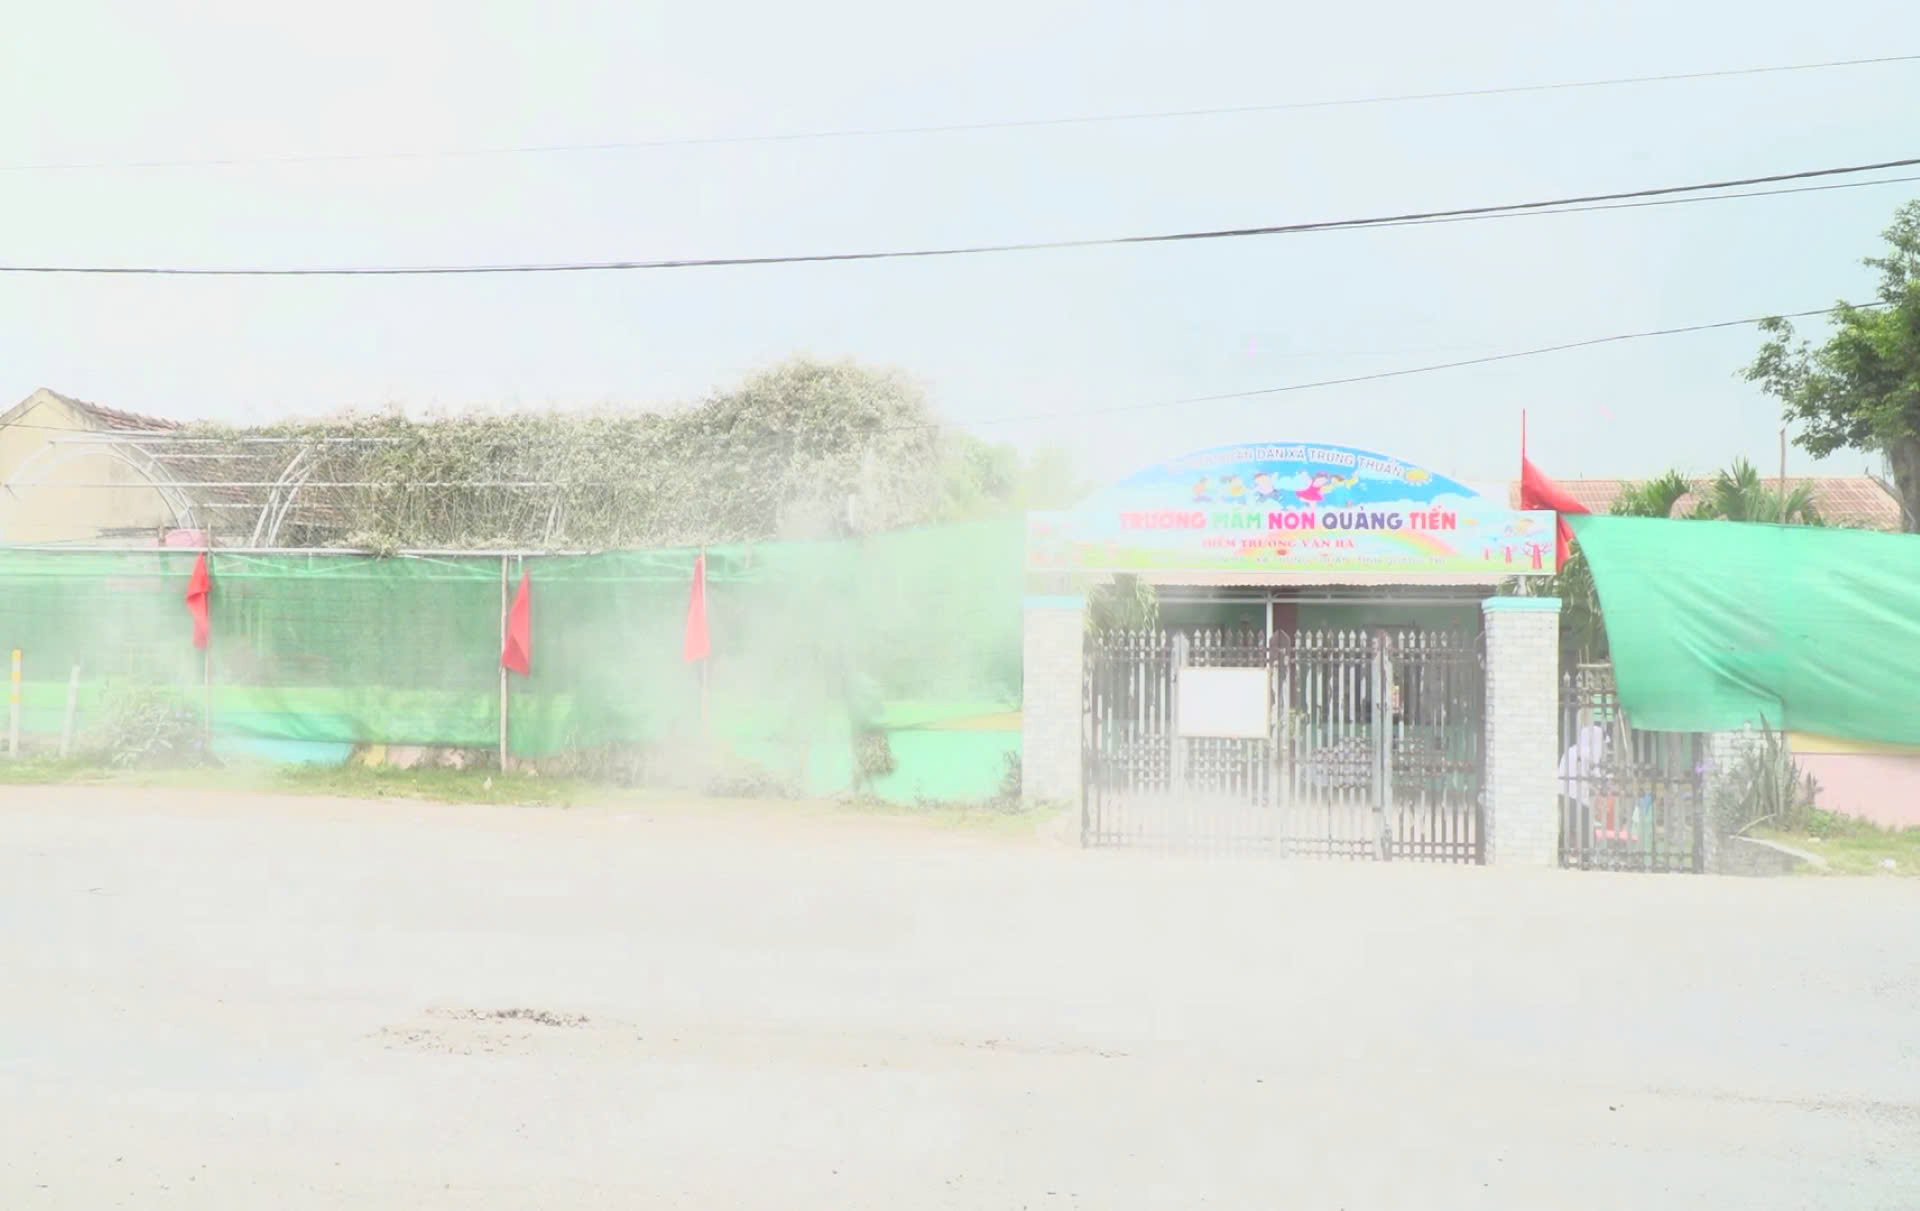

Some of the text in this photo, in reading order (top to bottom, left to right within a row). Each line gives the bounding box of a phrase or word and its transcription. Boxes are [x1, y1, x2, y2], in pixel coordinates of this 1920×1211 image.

[1309, 448, 1355, 465] TRUNG
[1267, 512, 1316, 530] NON
[1322, 506, 1403, 530] QUẢNG
[1408, 505, 1456, 530] TIẾN
